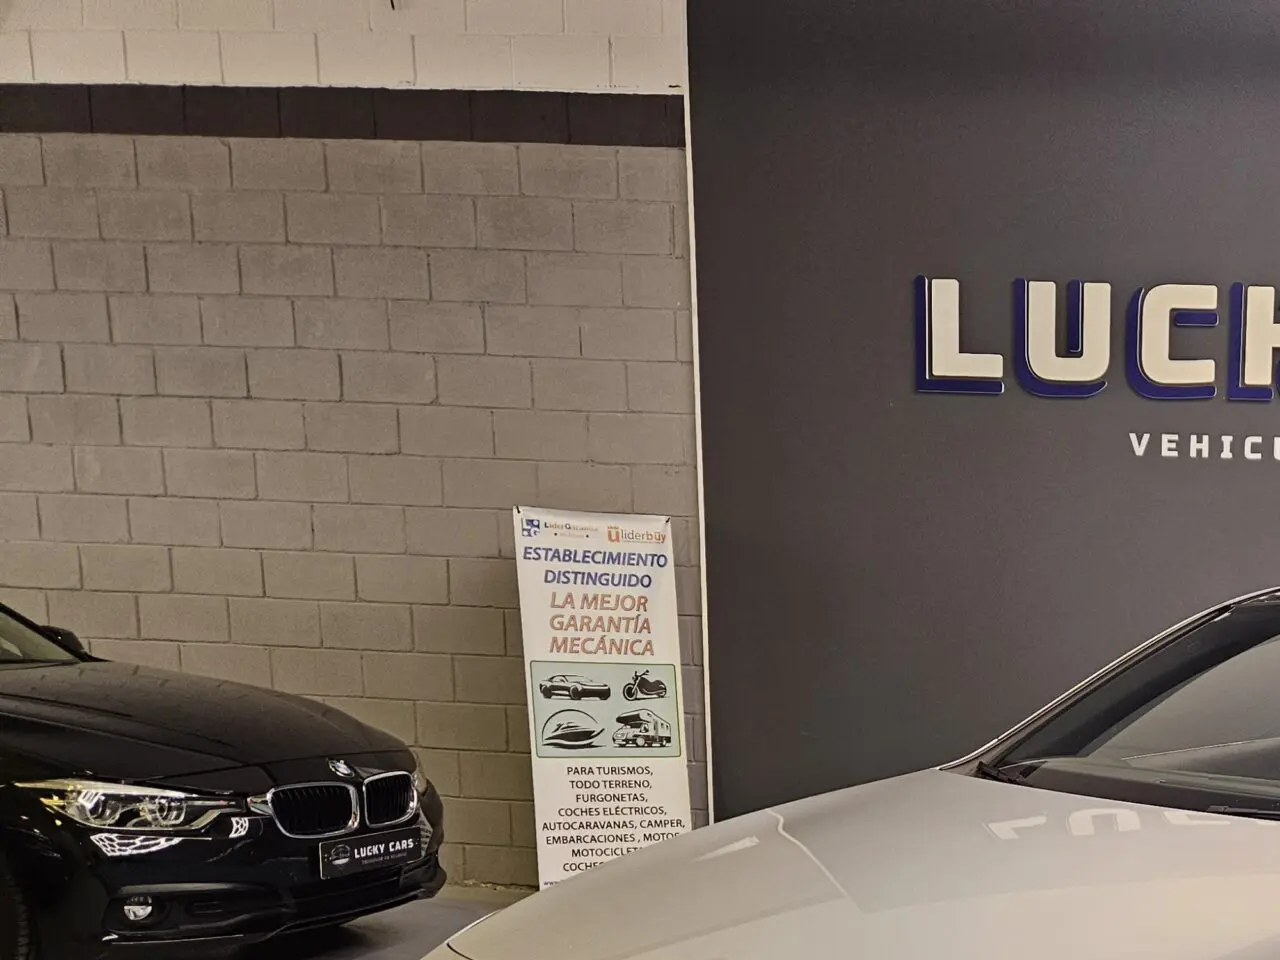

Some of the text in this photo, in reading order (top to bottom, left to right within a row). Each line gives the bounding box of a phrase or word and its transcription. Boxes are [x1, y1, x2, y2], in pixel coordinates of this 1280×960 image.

[523, 547, 668, 567] ESTABLECIMIENTO
[544, 570, 652, 588] DISTINGUIDO
[550, 592, 648, 612] LA MEJOR
[549, 614, 651, 634] GARANTÍA
[549, 635, 654, 656] MECÁNICA
[567, 766, 653, 776] PARA TURISMOS,
[569, 780, 652, 789] TODO TERRENO,
[576, 793, 648, 803] FURGONETAS,
[558, 806, 667, 817] COCHES ELÉCTRICOS,
[542, 819, 685, 831] AUTOCARAVANAS, CAMPER,
[546, 834, 635, 845] EMBARCACIONES
[354, 844, 385, 859] LUCKY
[388, 838, 414, 851] CARS
[572, 847, 642, 858] MOTOCICLET
[563, 861, 604, 872] COCHE
